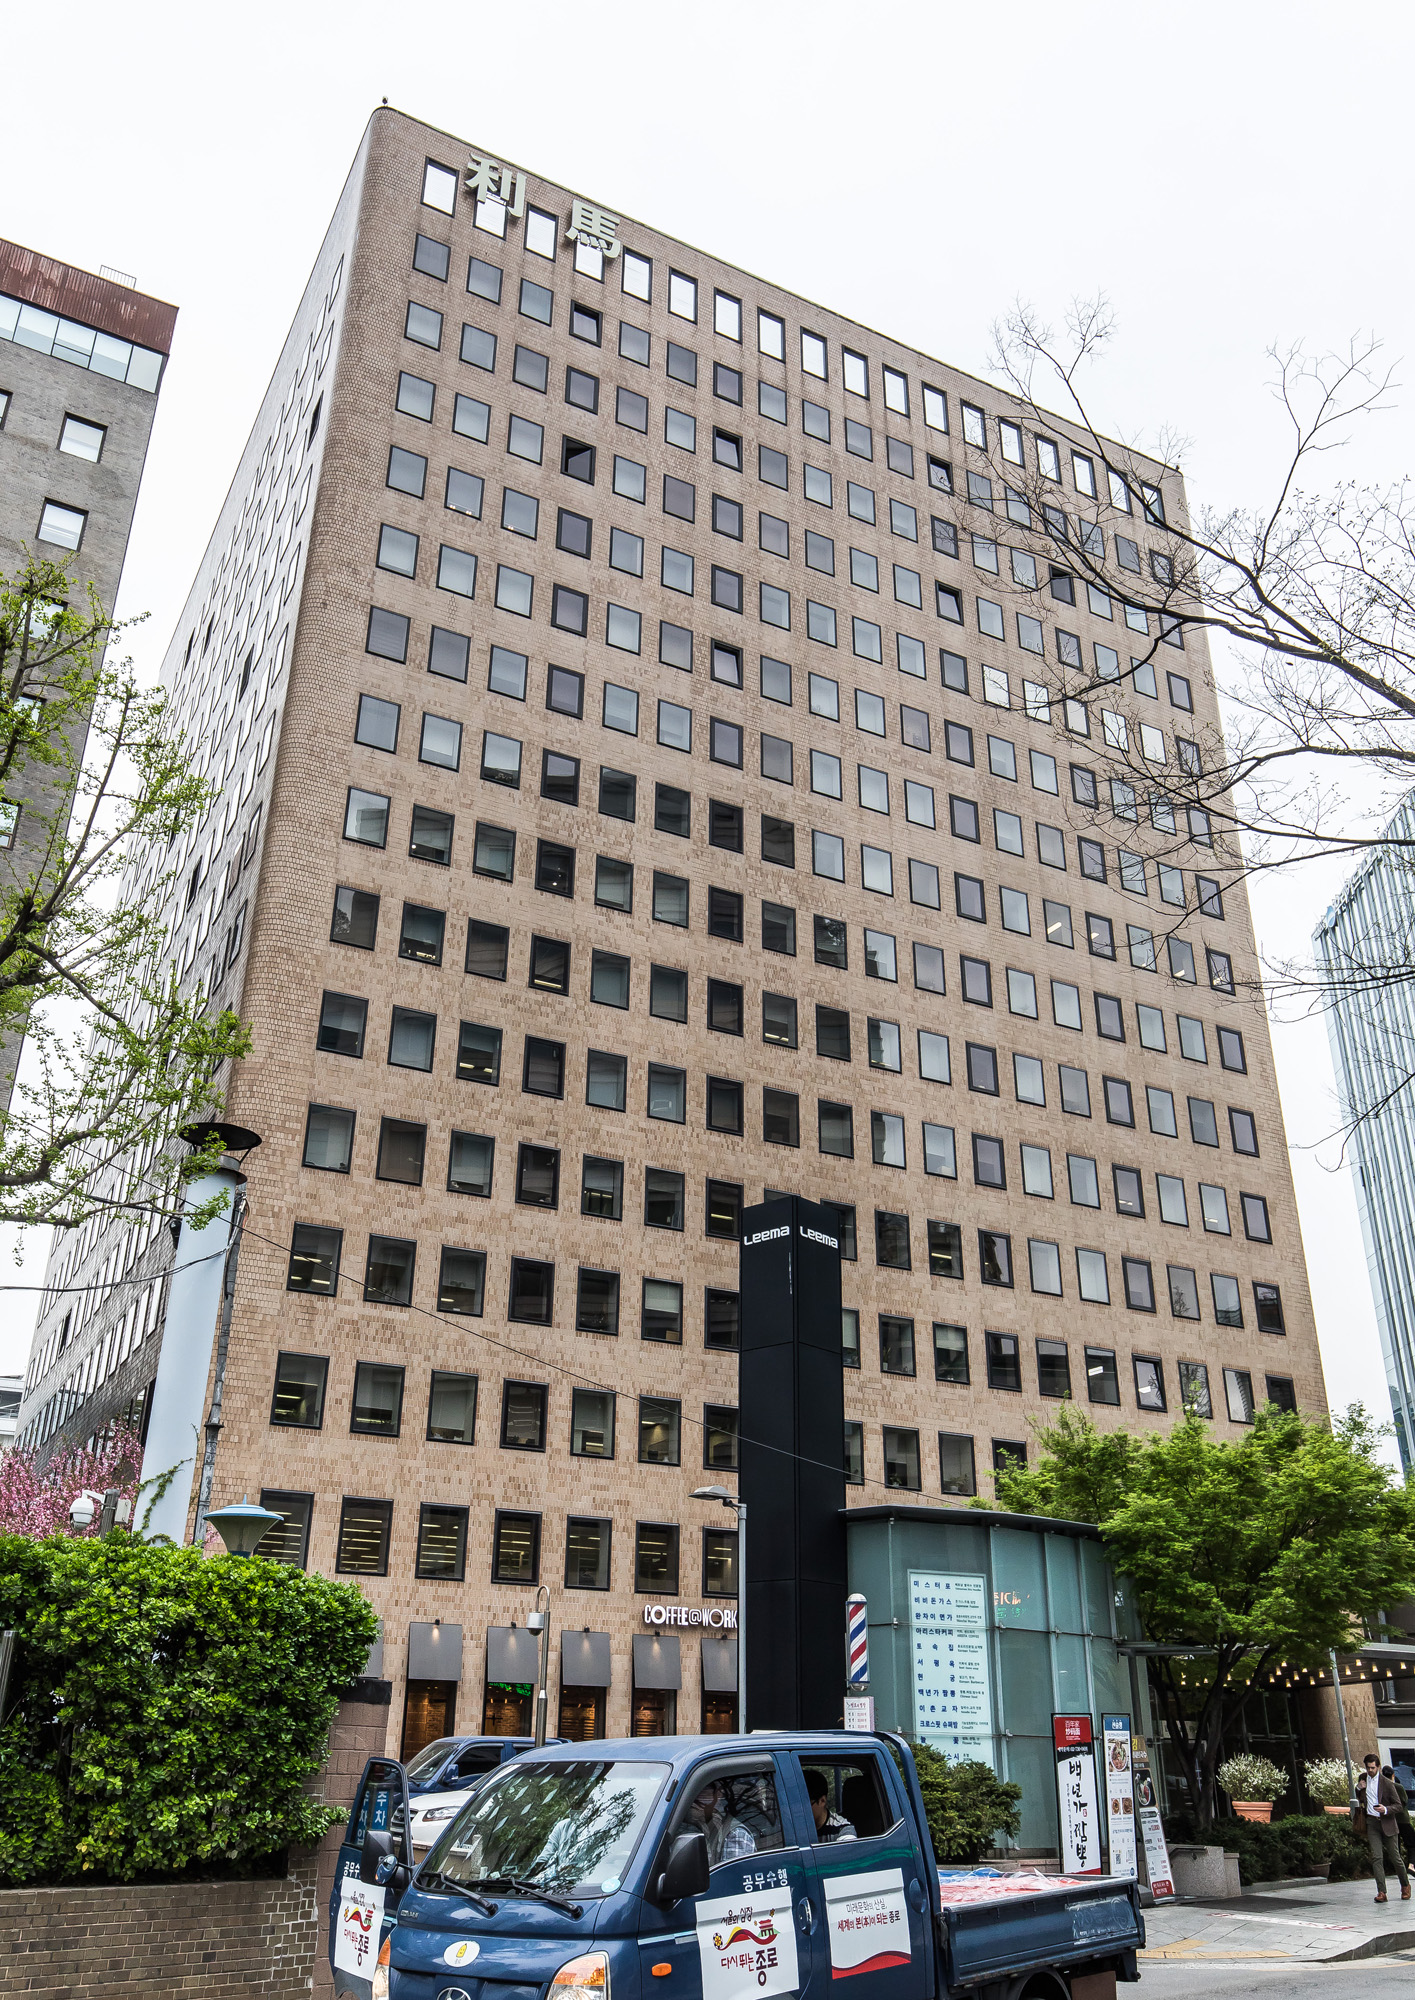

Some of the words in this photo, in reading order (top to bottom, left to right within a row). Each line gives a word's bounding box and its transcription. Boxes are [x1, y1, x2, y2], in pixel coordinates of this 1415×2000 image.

[915, 1627, 954, 1636] 아리스타커피
[374, 1791, 388, 1826] 주차
[343, 1861, 361, 1878] 공무수
[742, 1868, 788, 1893] 공무수행
[721, 1909, 740, 1926] 서울의
[740, 1906, 753, 1923] 심장
[846, 1901, 874, 1914] 미래문화의
[837, 1917, 855, 1932] 세계의
[876, 1912, 888, 1925] 되는
[888, 1910, 901, 1924] 종로
[721, 1954, 738, 1969] 다시
[739, 1953, 754, 1972] 뛰는
[755, 1947, 779, 1987] 종로
